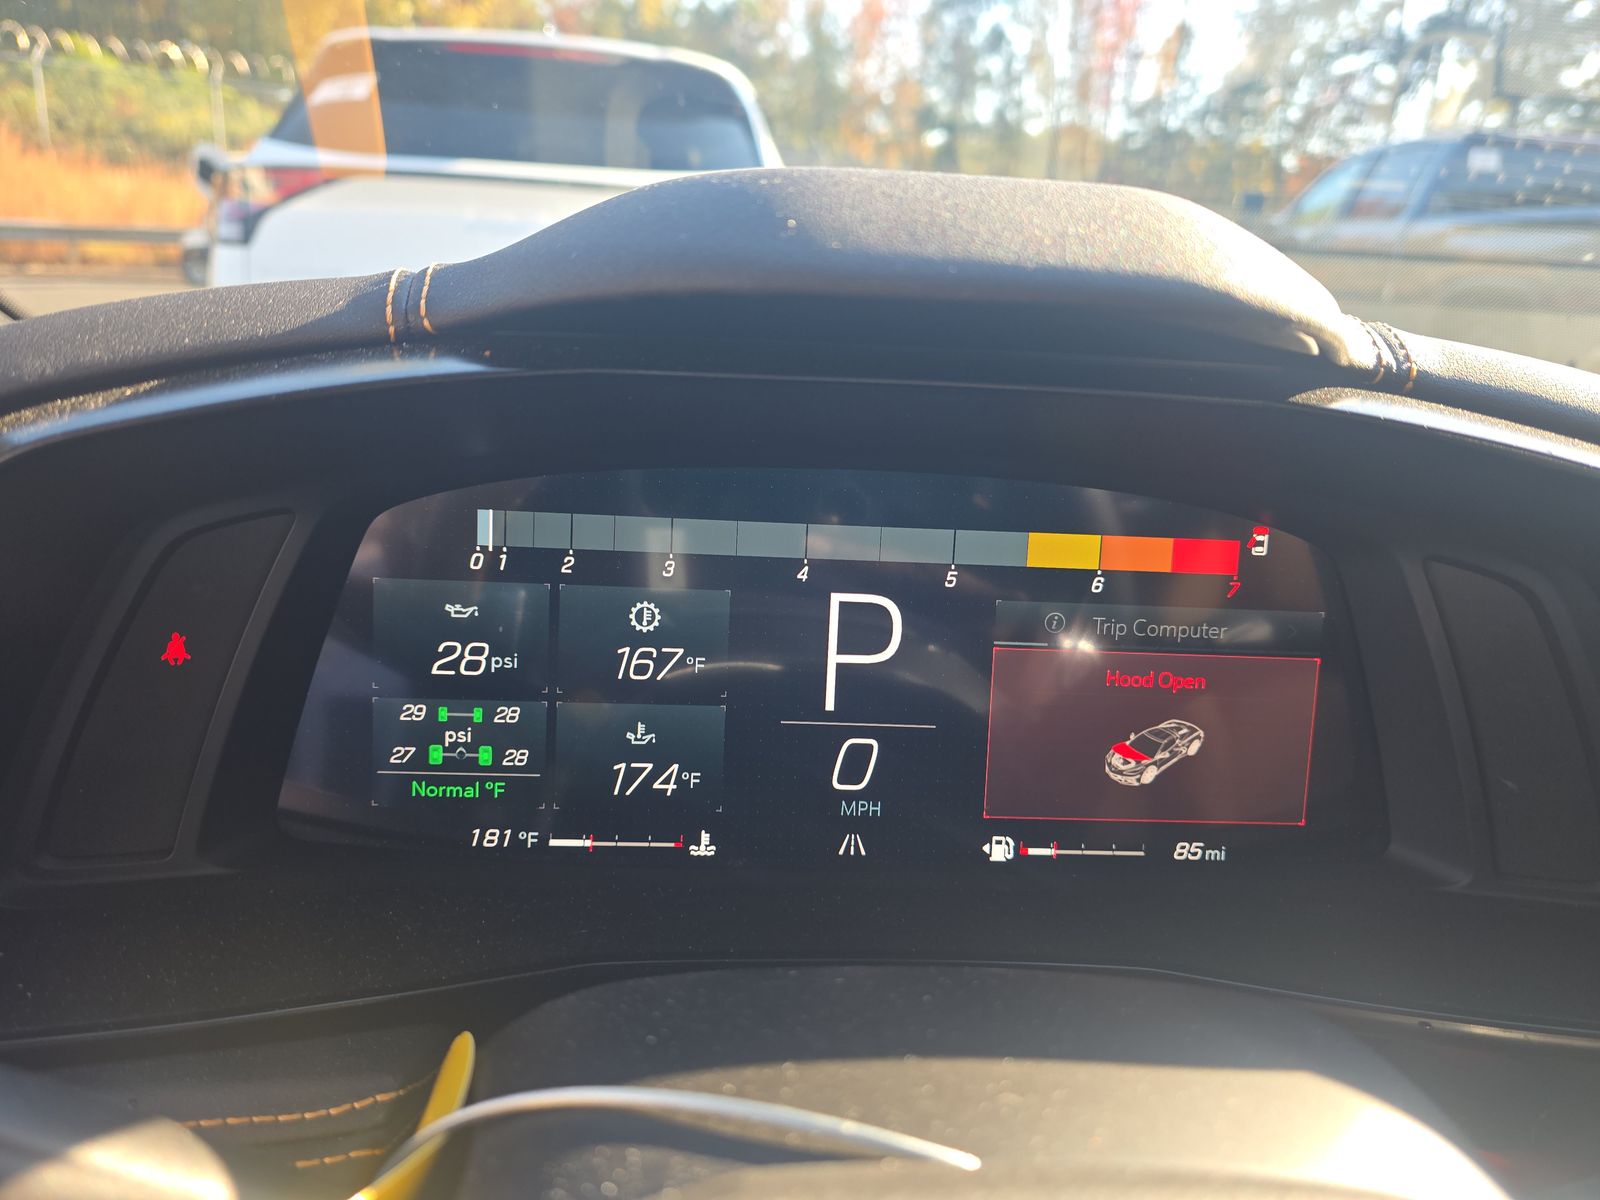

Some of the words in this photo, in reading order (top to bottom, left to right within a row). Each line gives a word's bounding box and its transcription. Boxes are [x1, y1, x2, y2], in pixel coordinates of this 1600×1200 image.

[469, 552, 485, 570] 0
[499, 553, 507, 571] 1
[560, 556, 575, 574] 2
[662, 560, 676, 577] 3
[796, 565, 809, 583] 4
[944, 570, 959, 588] 5
[1091, 576, 1105, 593] 6
[1227, 581, 1241, 598] 7
[1092, 617, 1127, 641] Trip
[1133, 618, 1229, 643] Computer
[430, 641, 490, 676] 28
[490, 653, 518, 673] psi
[824, 592, 903, 712] P
[617, 646, 685, 681] 167
[1106, 669, 1155, 688] Hood
[1157, 671, 1207, 693] Open
[400, 703, 427, 721] 29
[493, 706, 521, 723] 28
[444, 726, 472, 747] psi
[389, 746, 416, 764] 27
[501, 749, 529, 766] 28
[832, 738, 879, 791] 0
[411, 780, 480, 799] Normal
[613, 762, 680, 797] 174
[840, 800, 881, 817] MPH
[471, 828, 512, 848] 181
[1173, 841, 1205, 861] 85
[1205, 846, 1226, 861] mi
